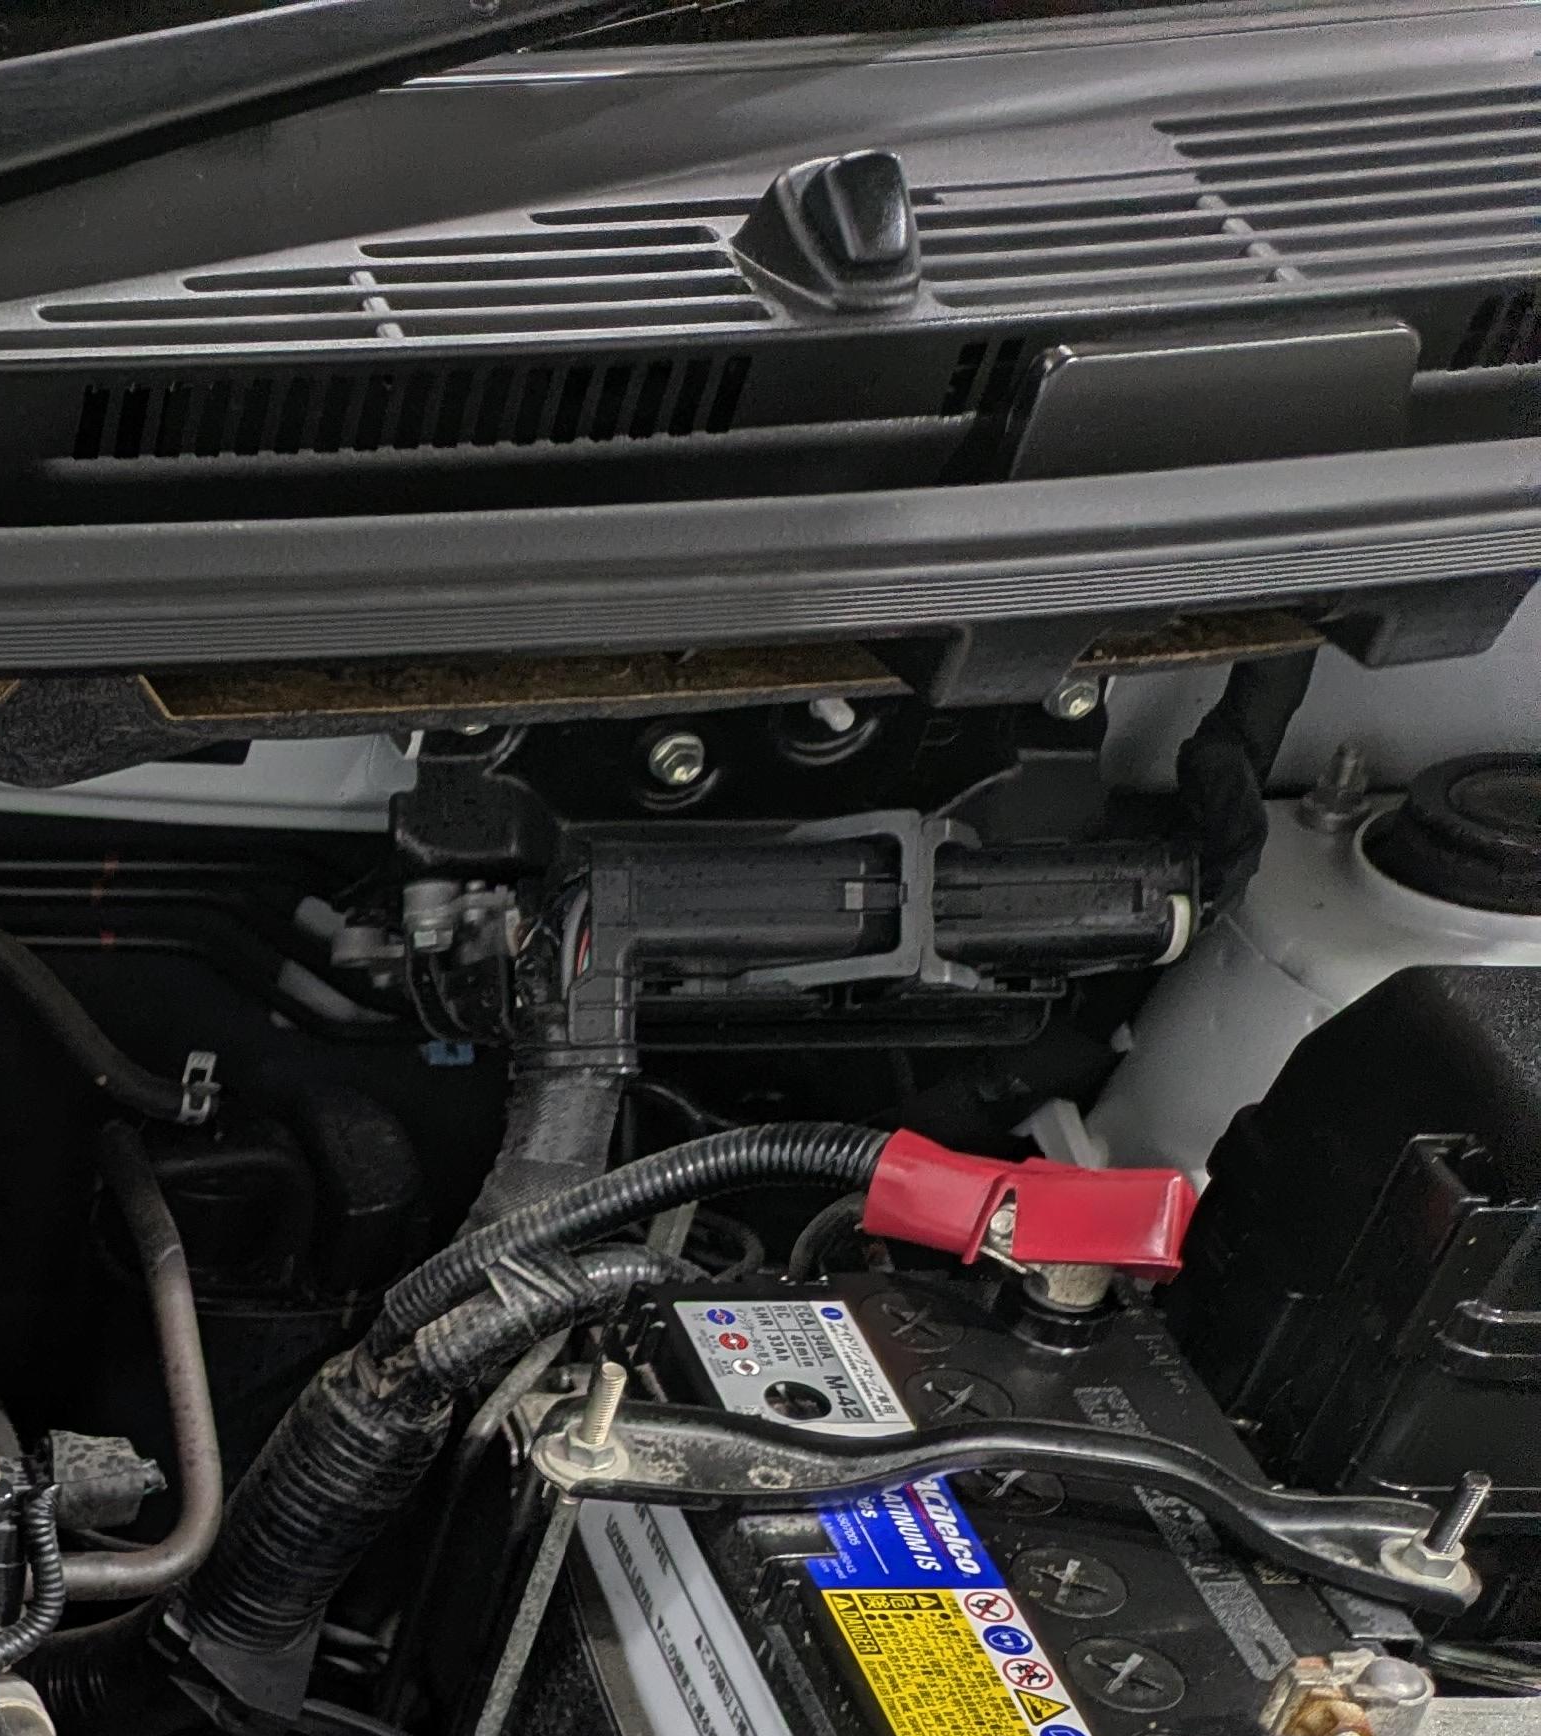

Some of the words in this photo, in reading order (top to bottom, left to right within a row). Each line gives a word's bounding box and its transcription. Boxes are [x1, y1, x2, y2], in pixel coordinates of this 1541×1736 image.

[794, 1304, 816, 1326] CCA
[823, 1375, 863, 1419] M-42
[913, 1554, 942, 1572] IS
[836, 1610, 881, 1652] DANGER
